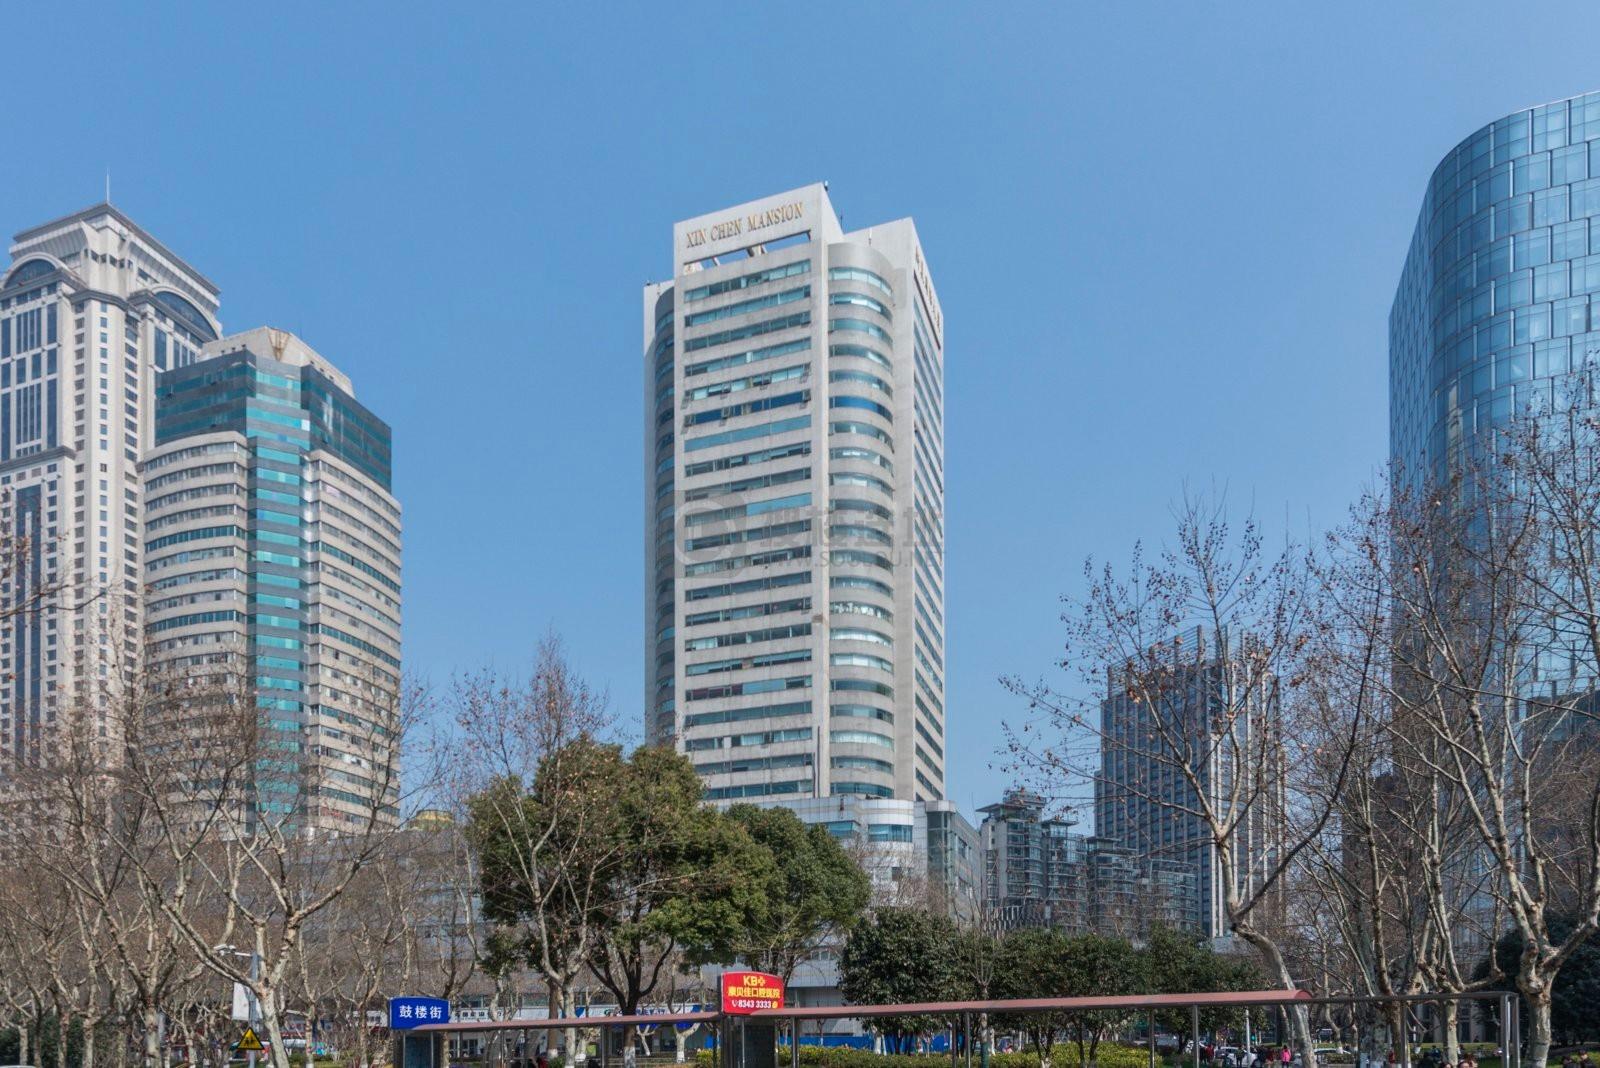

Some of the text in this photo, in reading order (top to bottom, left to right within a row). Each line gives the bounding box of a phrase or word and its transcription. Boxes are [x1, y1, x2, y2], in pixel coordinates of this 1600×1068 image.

[686, 201, 804, 248] XIN CHEN MANSION
[399, 1004, 442, 1019] 鼓楼街
